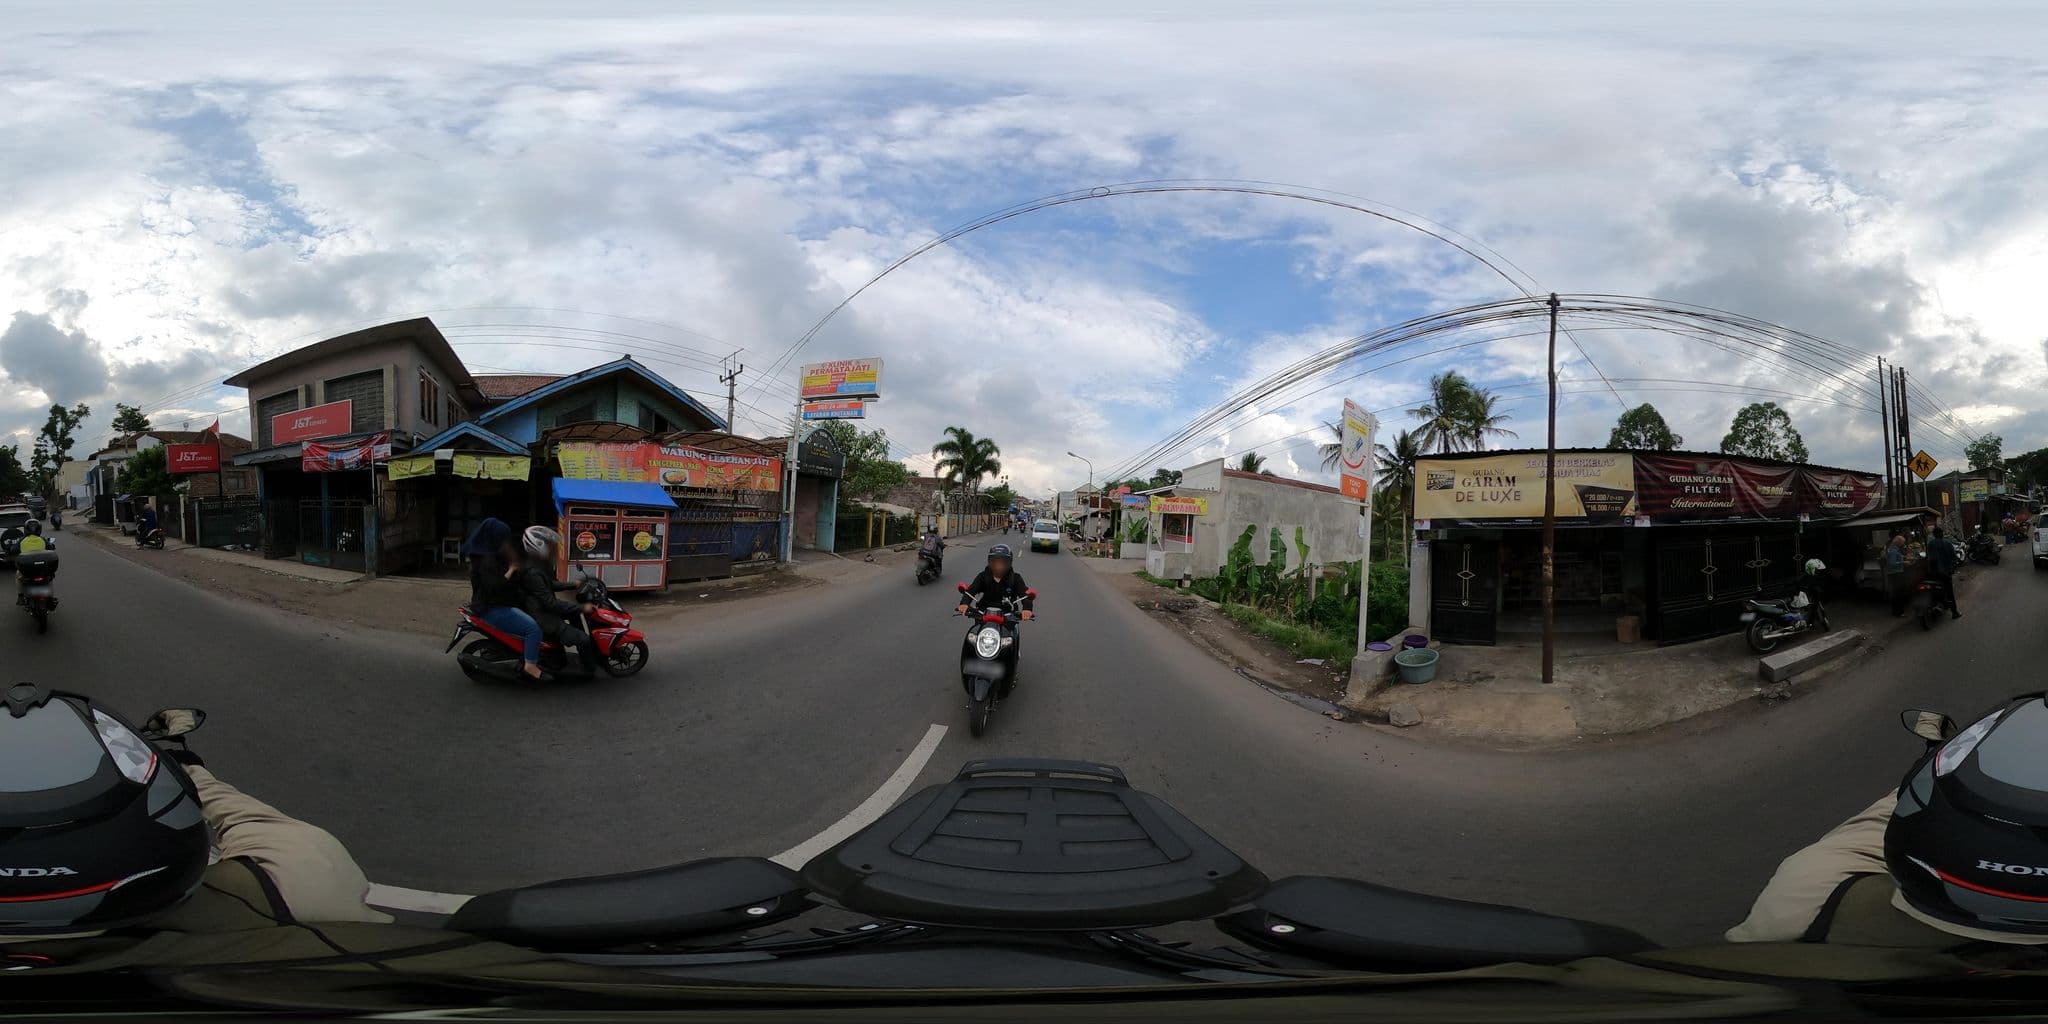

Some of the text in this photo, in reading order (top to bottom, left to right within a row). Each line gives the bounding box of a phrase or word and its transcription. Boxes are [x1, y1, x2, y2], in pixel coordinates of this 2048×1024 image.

[291, 416, 313, 430] J&T
[176, 451, 199, 462] J&T
[660, 447, 706, 460] WARUNG
[1472, 468, 1505, 477] GUDANG
[1461, 476, 1517, 488] GARAM
[1669, 475, 1733, 484] GUDANG GARAM
[1684, 485, 1720, 493] FILTER
[1455, 488, 1522, 504] DE LUXE
[1669, 497, 1735, 509] International
